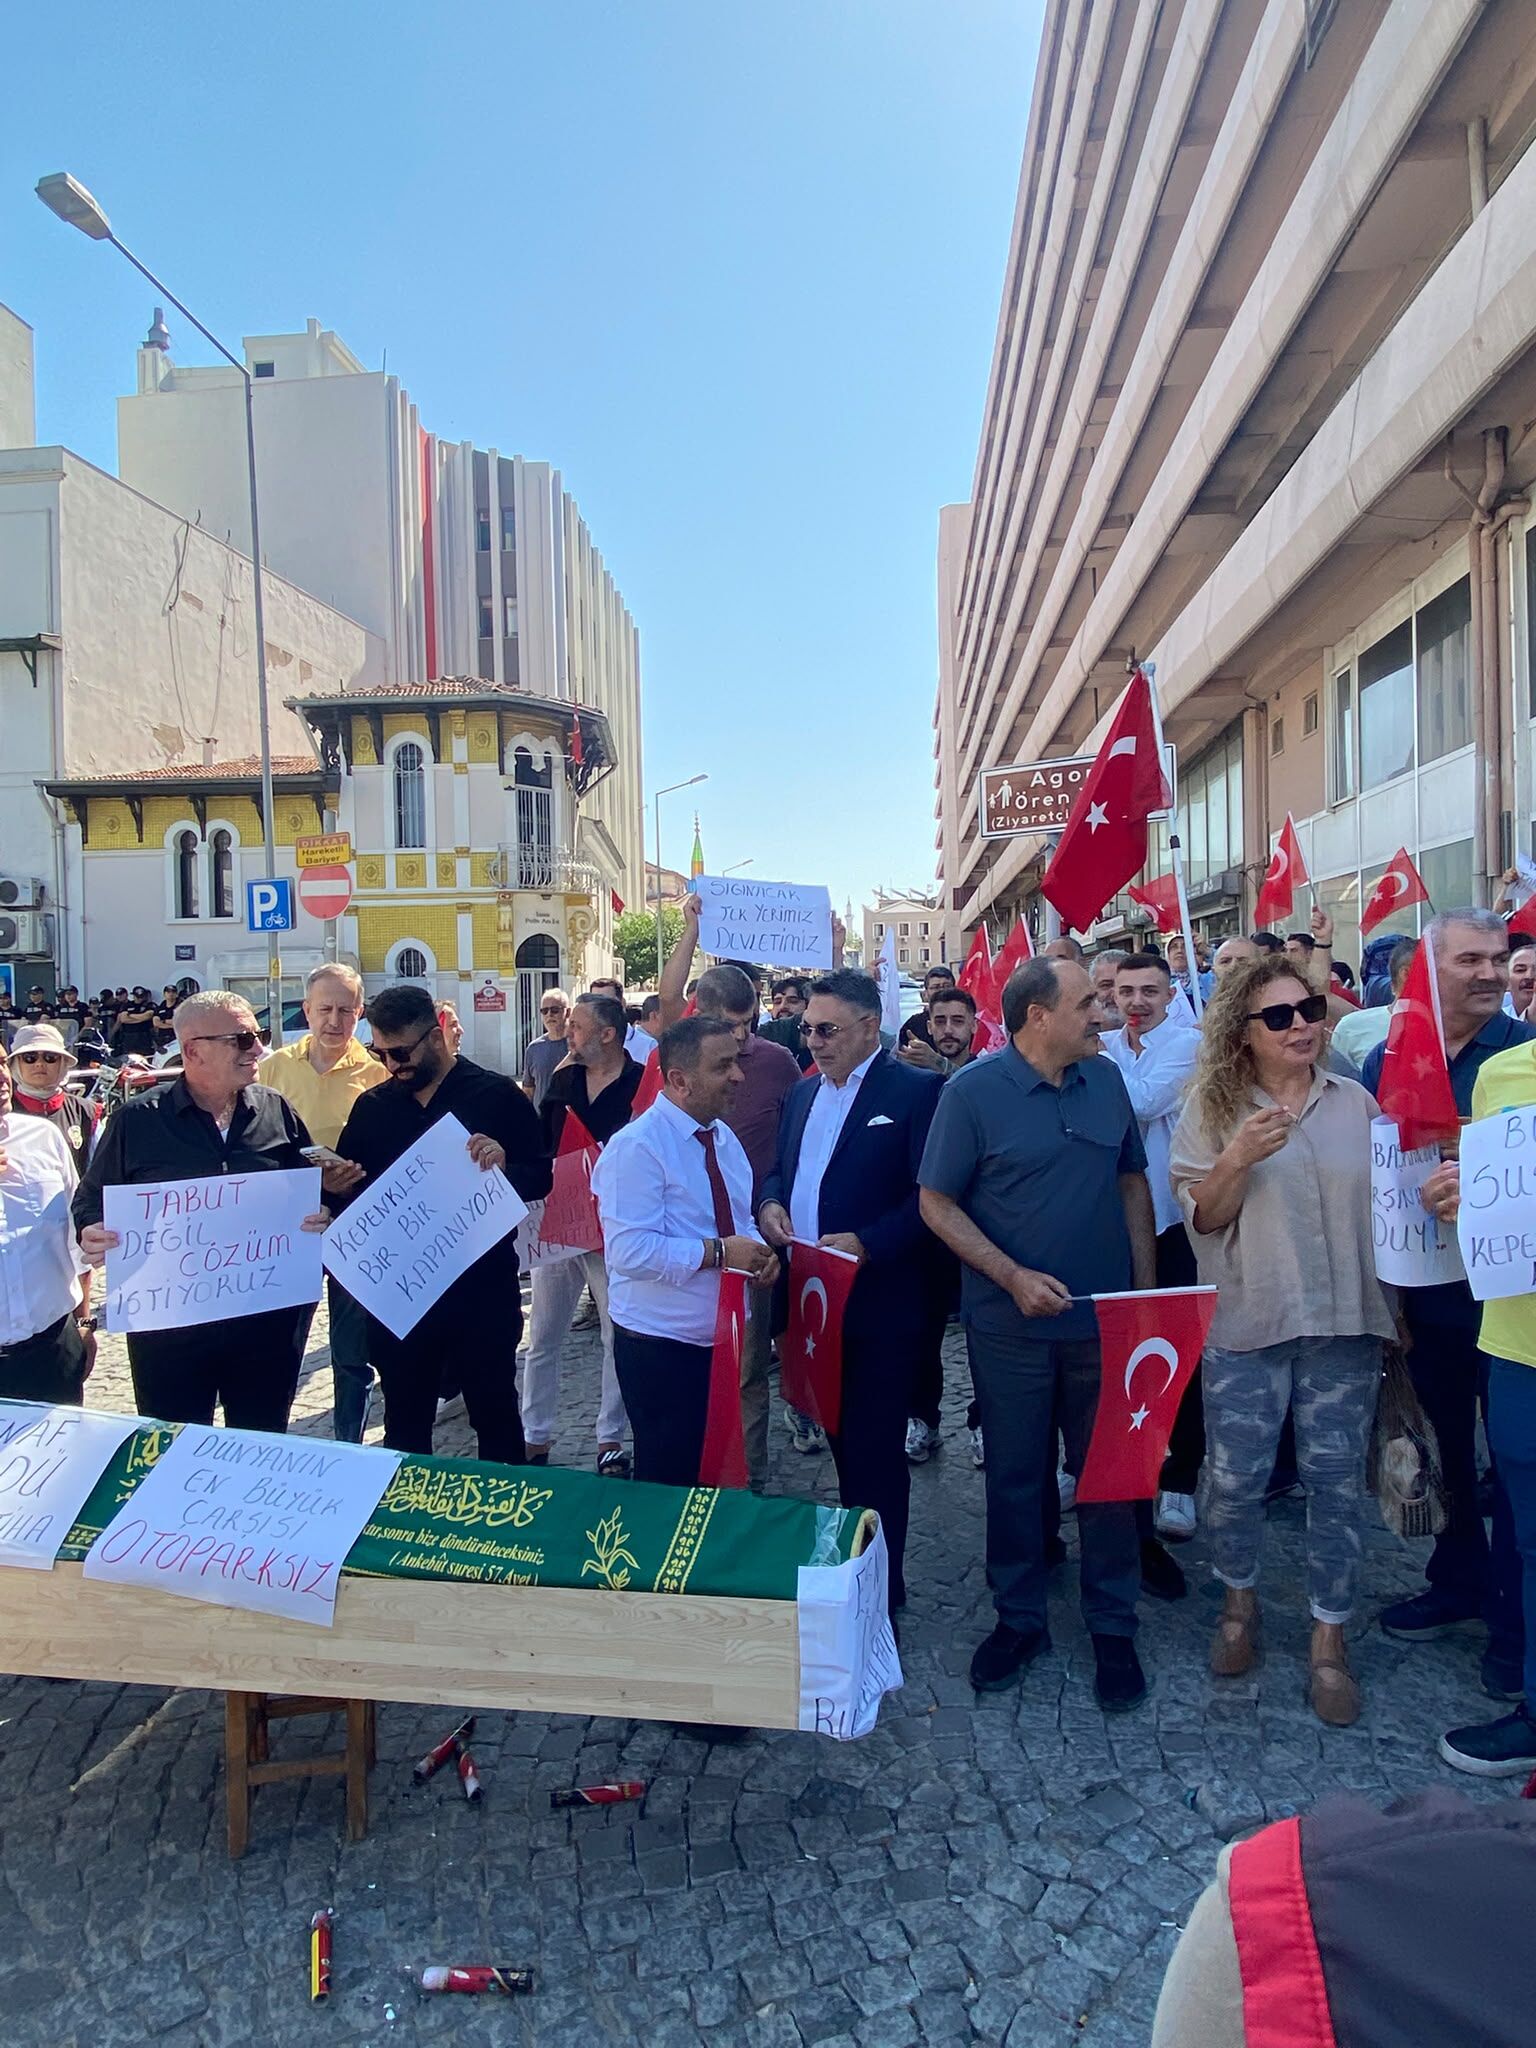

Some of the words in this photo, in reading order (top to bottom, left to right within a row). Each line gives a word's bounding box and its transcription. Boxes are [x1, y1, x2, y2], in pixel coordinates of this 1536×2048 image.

[1015, 790, 1070, 810] Ören
[302, 845, 344, 856] Hareketli
[305, 855, 340, 864] Bariyer
[252, 884, 279, 928] P
[136, 1179, 247, 1220] TABUT
[1469, 1163, 1536, 1209] SU
[329, 1153, 435, 1262] KEPENKLER
[397, 1200, 438, 1241] BİR
[122, 1217, 211, 1261] DEĞİL
[116, 1265, 282, 1316] İSTİYORUZ
[193, 1434, 342, 1478] DÜNYANIN
[183, 1468, 232, 1495] EN
[242, 1476, 345, 1516] BÜYÜK
[178, 1499, 308, 1540] ÇARŞISI
[100, 1519, 335, 1602] OTOPARKSIZ
[440, 1533, 545, 1565] döndürüleceksiniz
[448, 1561, 487, 1580] suresi
